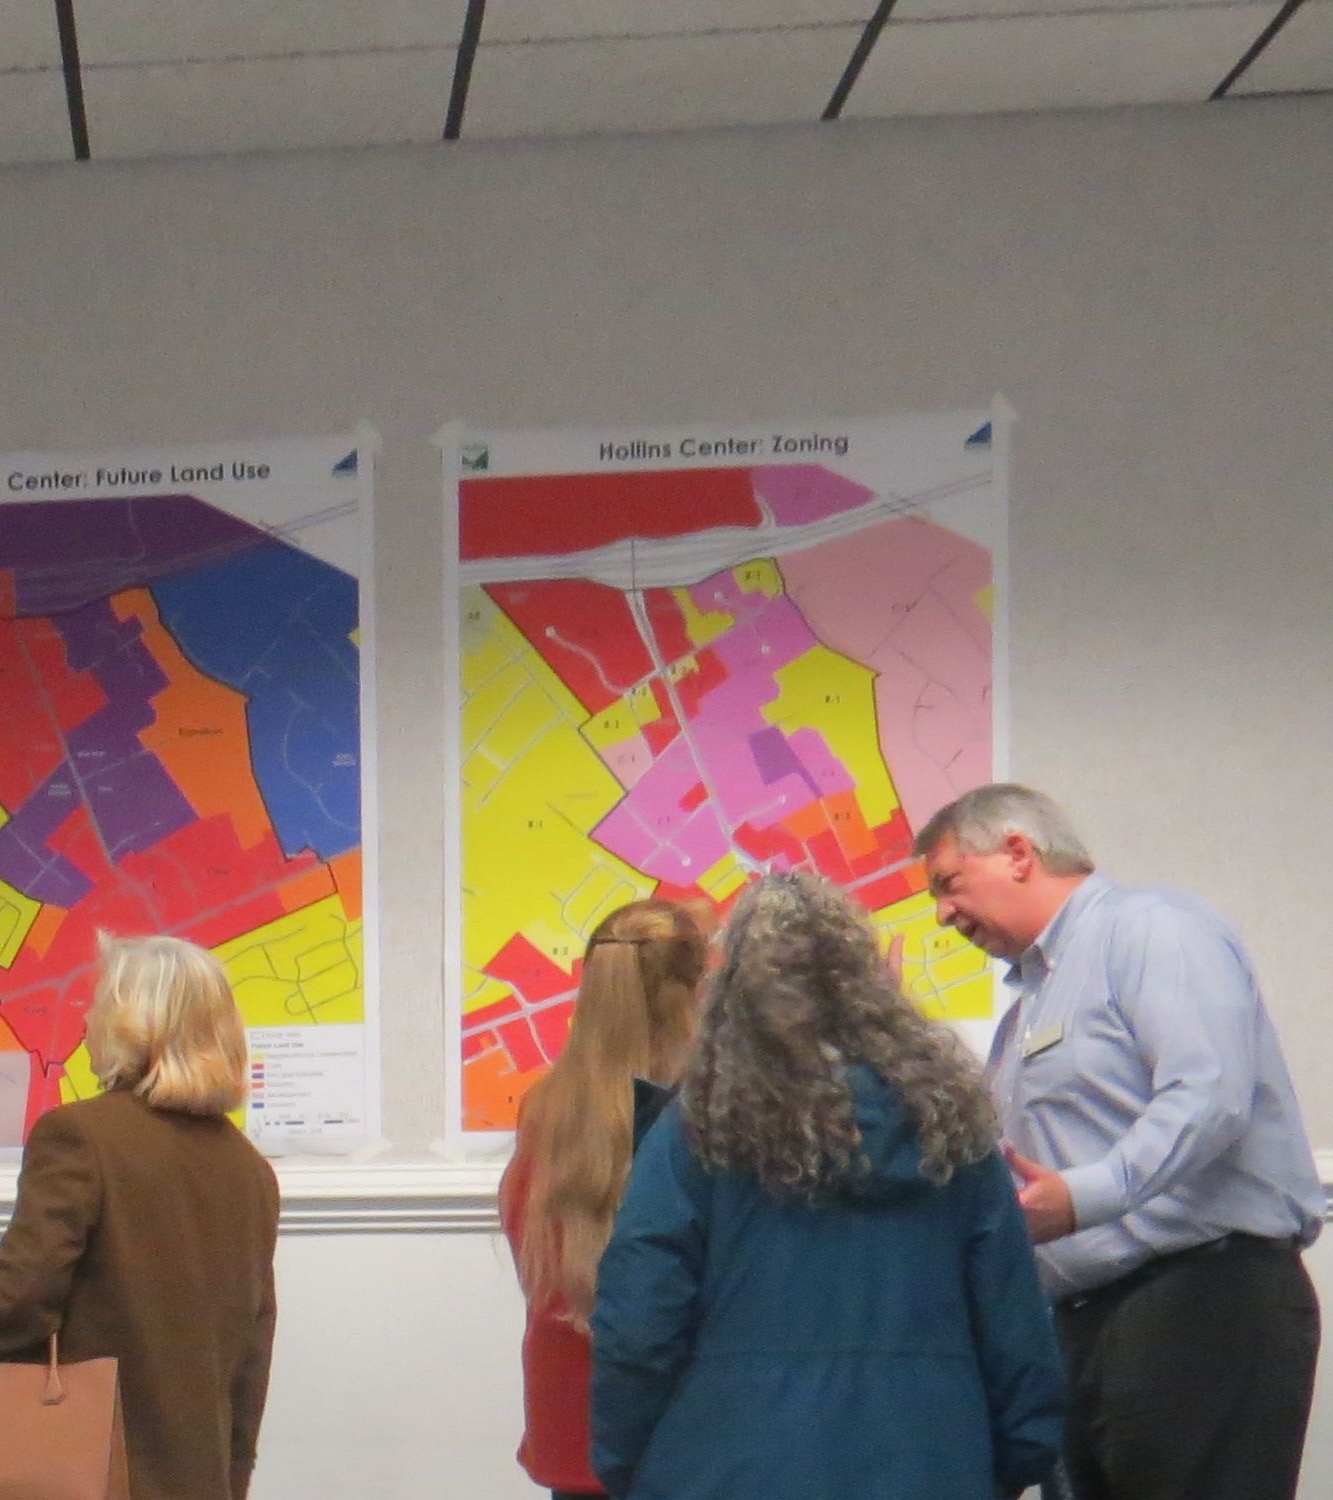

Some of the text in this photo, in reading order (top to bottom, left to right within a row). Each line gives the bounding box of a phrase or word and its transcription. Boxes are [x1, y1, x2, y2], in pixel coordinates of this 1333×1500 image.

[599, 434, 849, 462] Hollins Center: Zoning
[8, 470, 88, 491] Center:
[97, 466, 163, 487] Future
[171, 463, 225, 483] Land
[233, 462, 271, 481] Use
